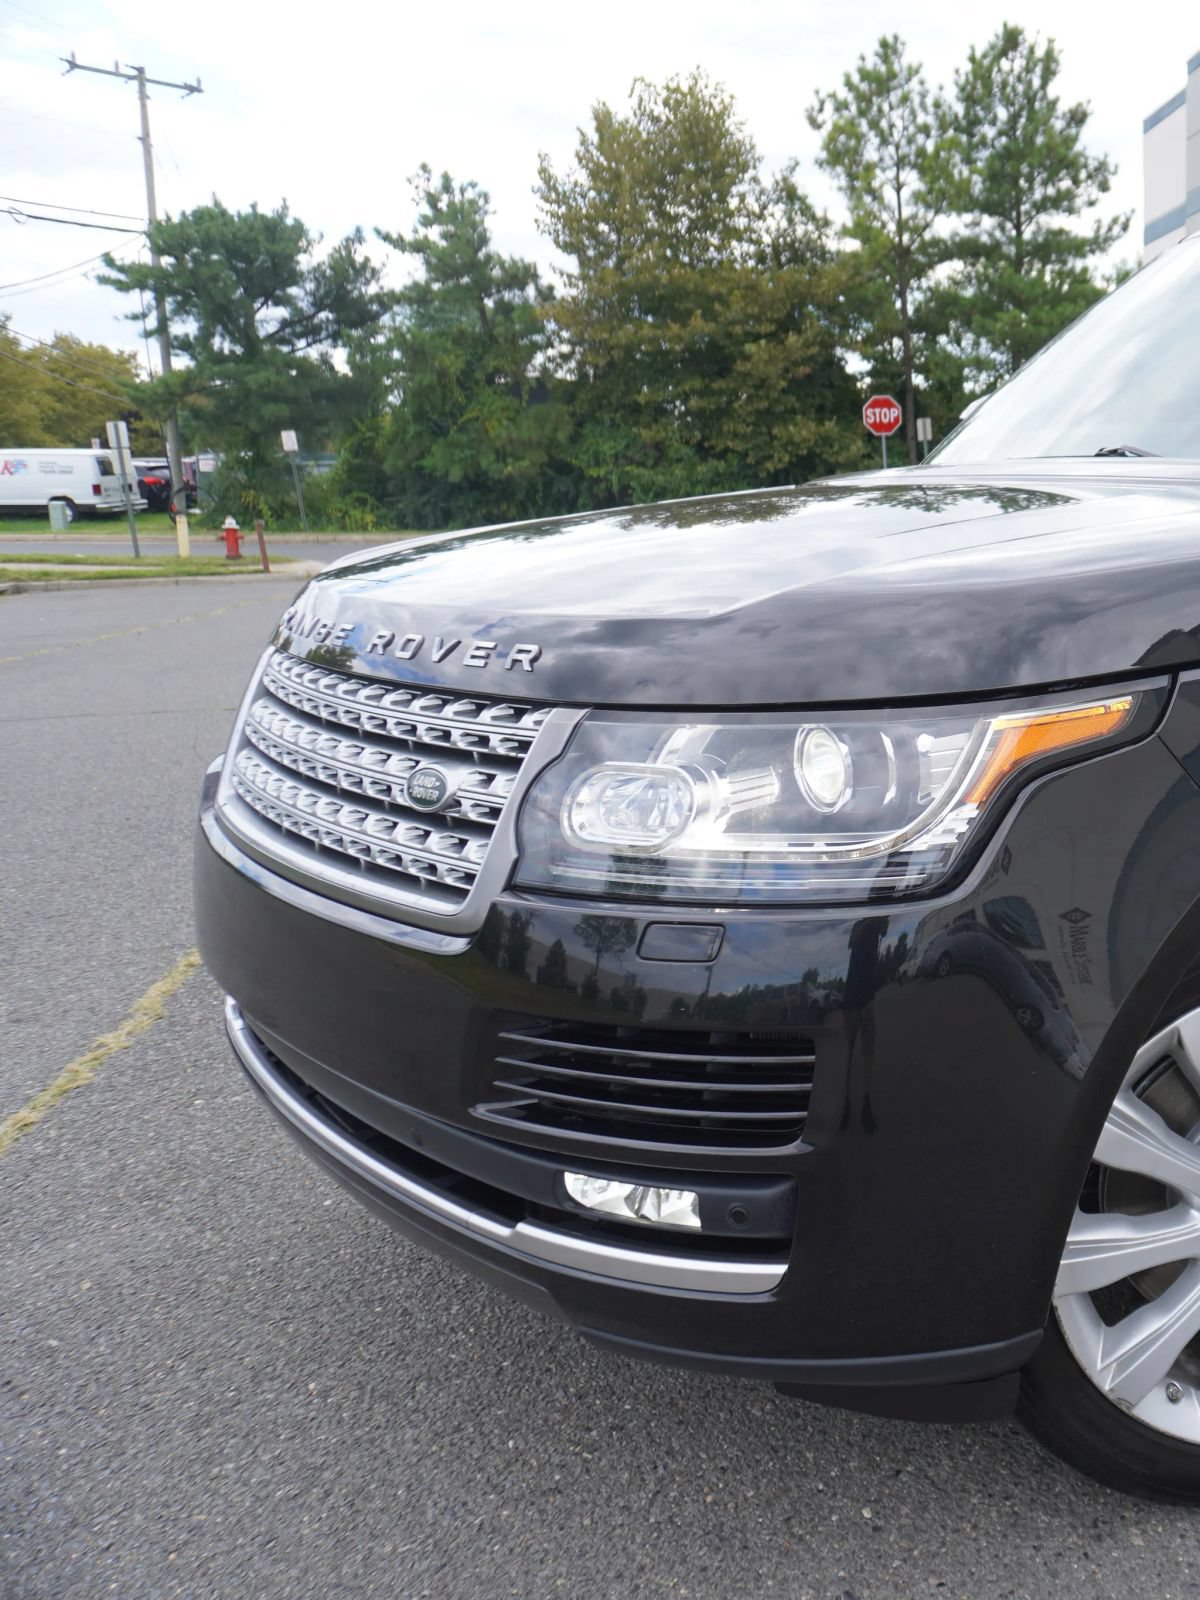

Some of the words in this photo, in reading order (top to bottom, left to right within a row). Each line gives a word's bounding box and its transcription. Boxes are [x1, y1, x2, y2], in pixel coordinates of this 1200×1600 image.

[866, 407, 899, 424] STOP
[279, 606, 356, 647] RANGE
[366, 629, 542, 672] ROVER
[413, 774, 437, 788] LAND
[411, 786, 440, 802] ROVER
